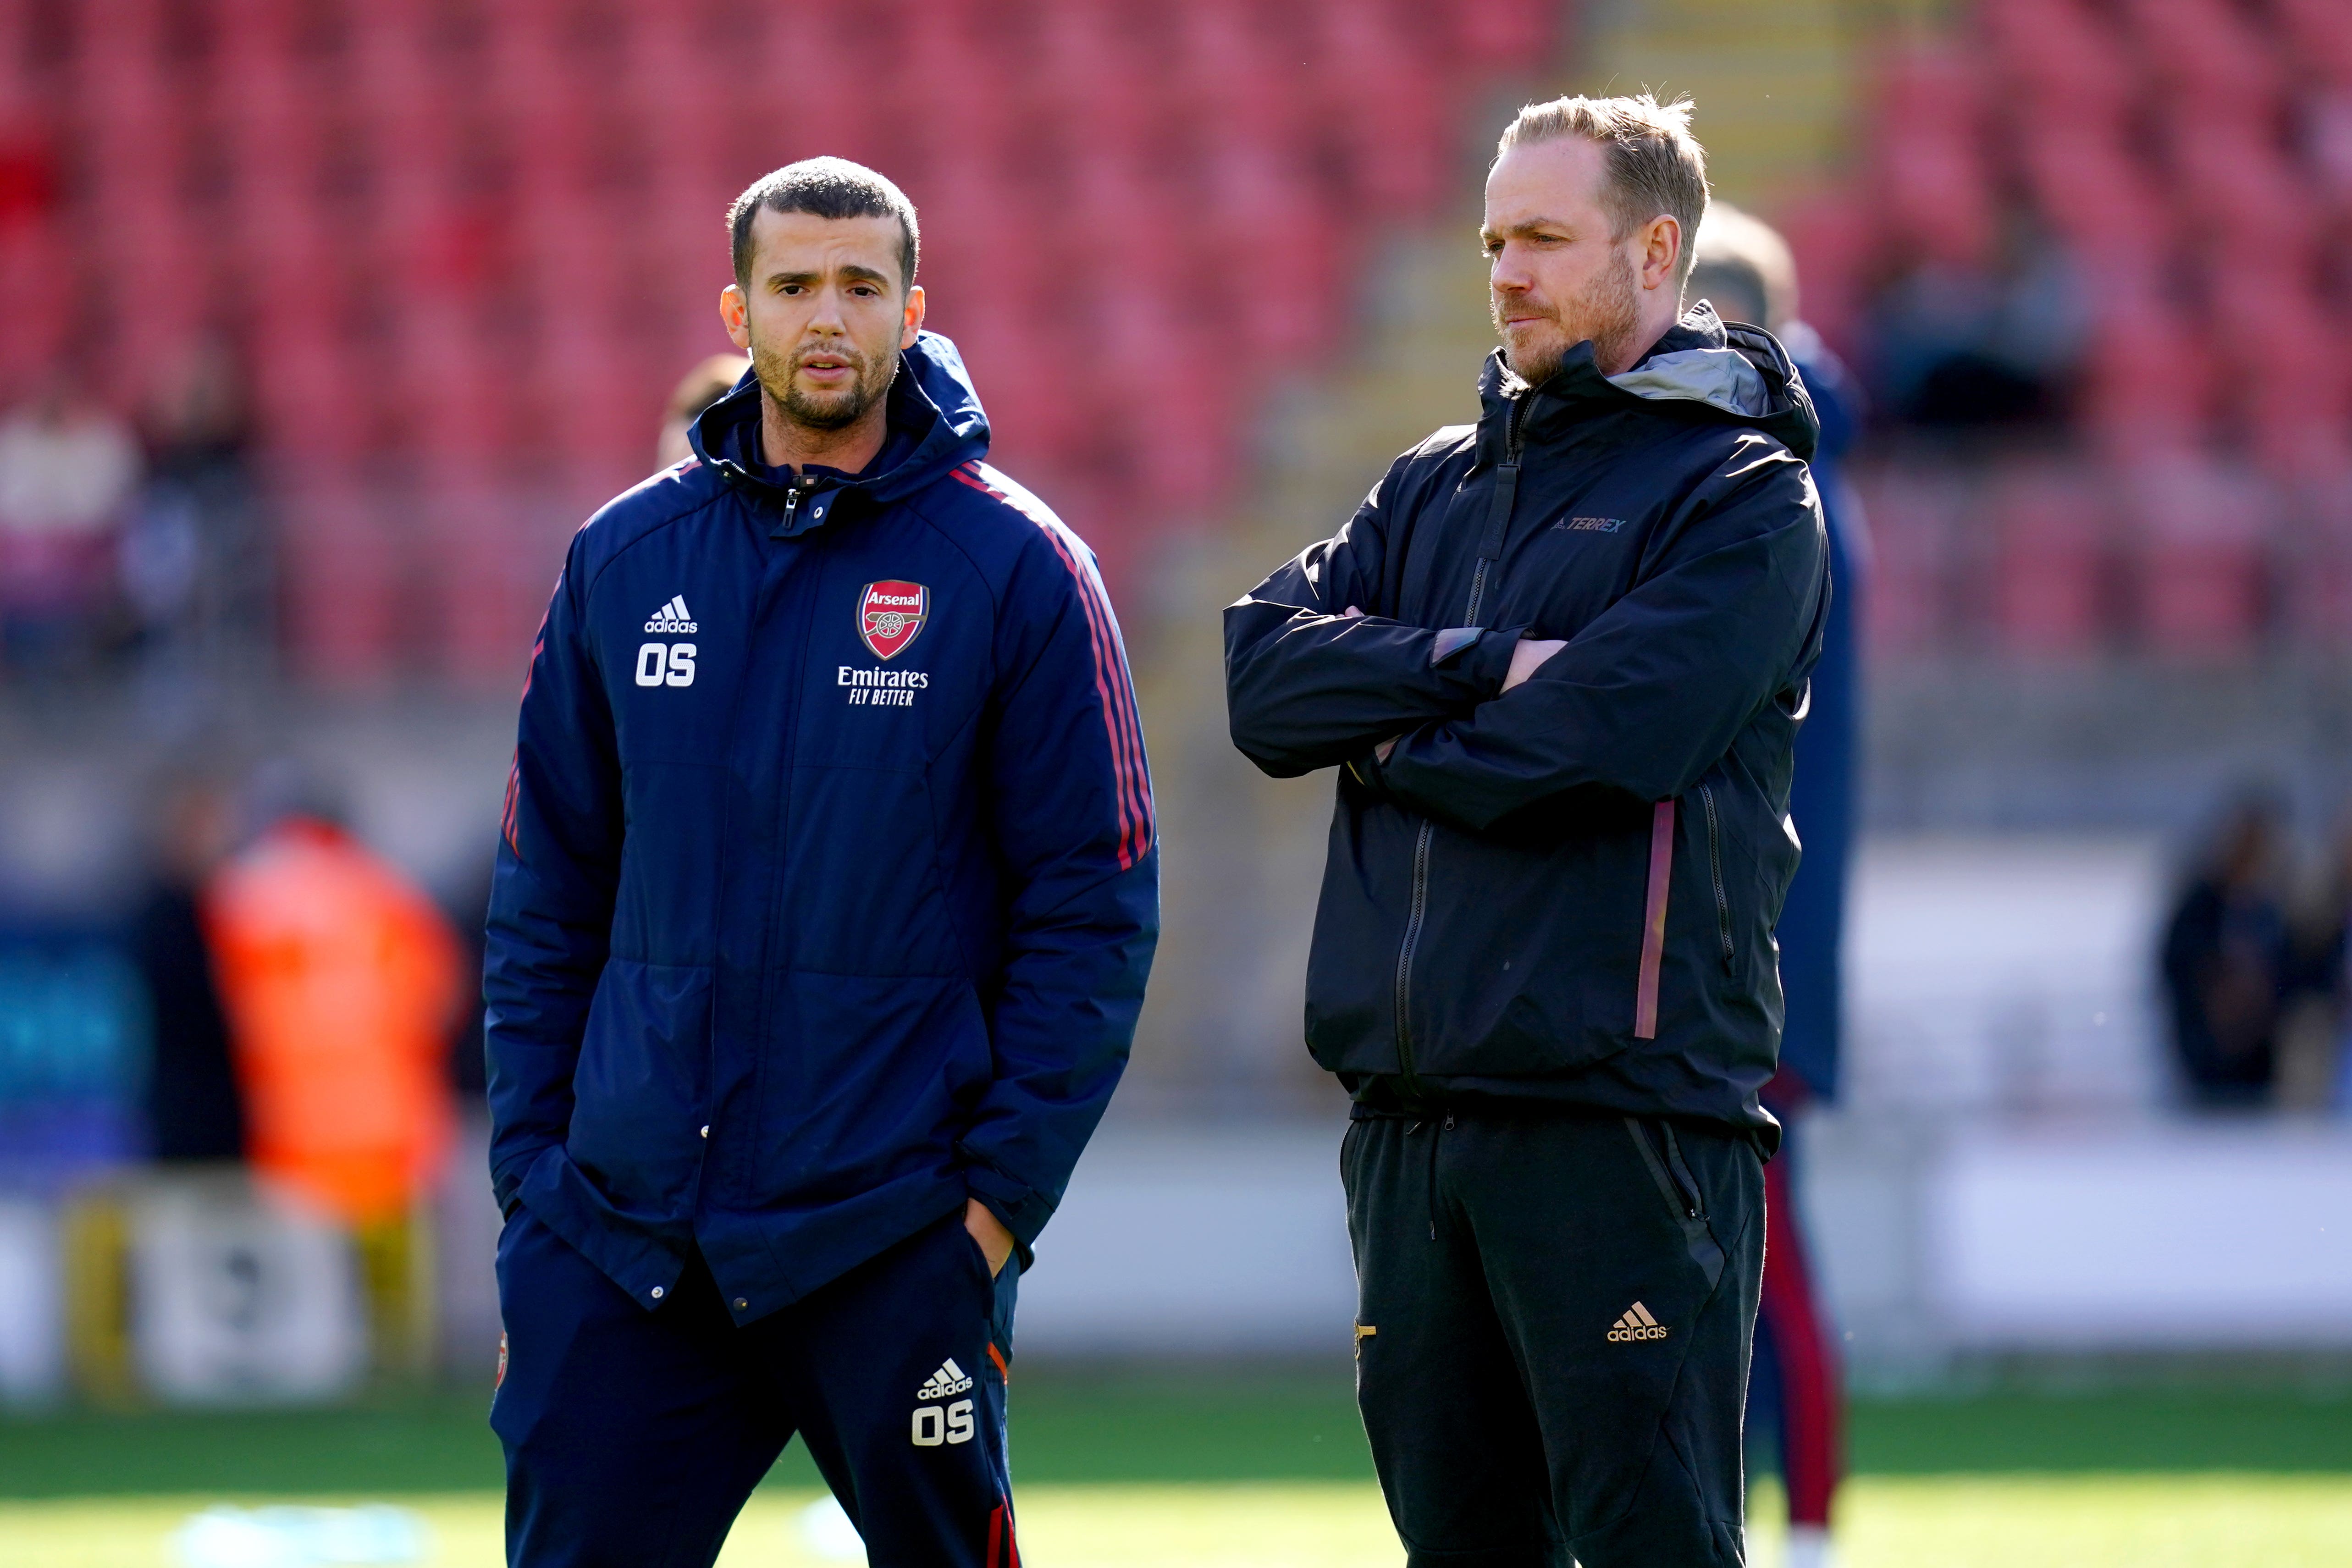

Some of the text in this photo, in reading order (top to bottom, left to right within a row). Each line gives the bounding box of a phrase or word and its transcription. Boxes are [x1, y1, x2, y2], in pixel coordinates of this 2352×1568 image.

[1567, 517, 1626, 533] TERREX
[868, 591, 919, 605] Arsenal
[644, 618, 698, 633] adidas
[635, 643, 697, 686] OS
[838, 666, 928, 689] Emirates
[849, 688, 914, 706] FLY BETTER
[1607, 1325, 1667, 1342] adidas
[917, 1376, 973, 1400] adidas
[912, 1399, 974, 1446] OS
